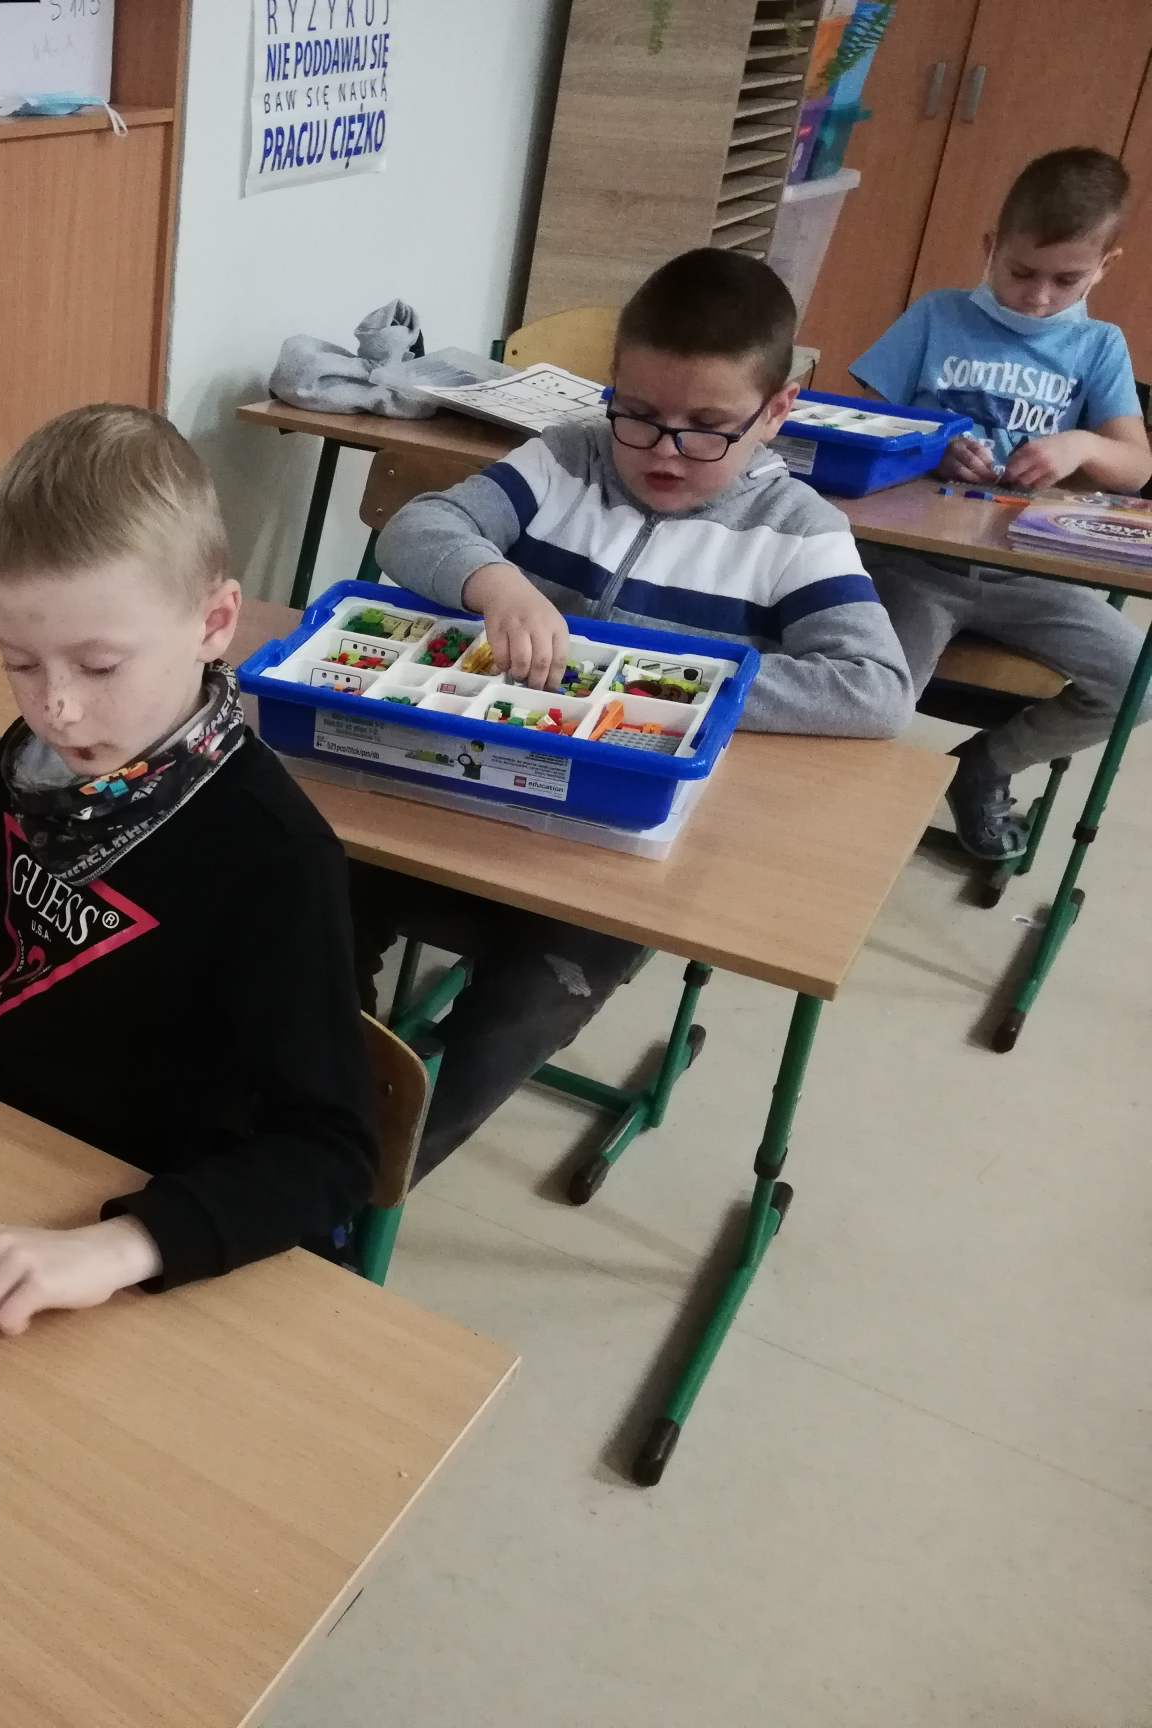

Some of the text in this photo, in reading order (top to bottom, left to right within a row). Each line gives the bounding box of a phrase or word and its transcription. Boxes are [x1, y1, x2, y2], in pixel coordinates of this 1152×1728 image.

[266, 43, 290, 82] NIE
[294, 35, 368, 79] PODDAWAJ
[264, 90, 296, 114] BAW
[259, 119, 329, 174] PRACUJ
[936, 355, 1078, 408] SOUTHSIDE
[1007, 398, 1066, 435] DOCK
[12, 854, 101, 946] GUESS
[31, 920, 52, 942] U.S.A.
